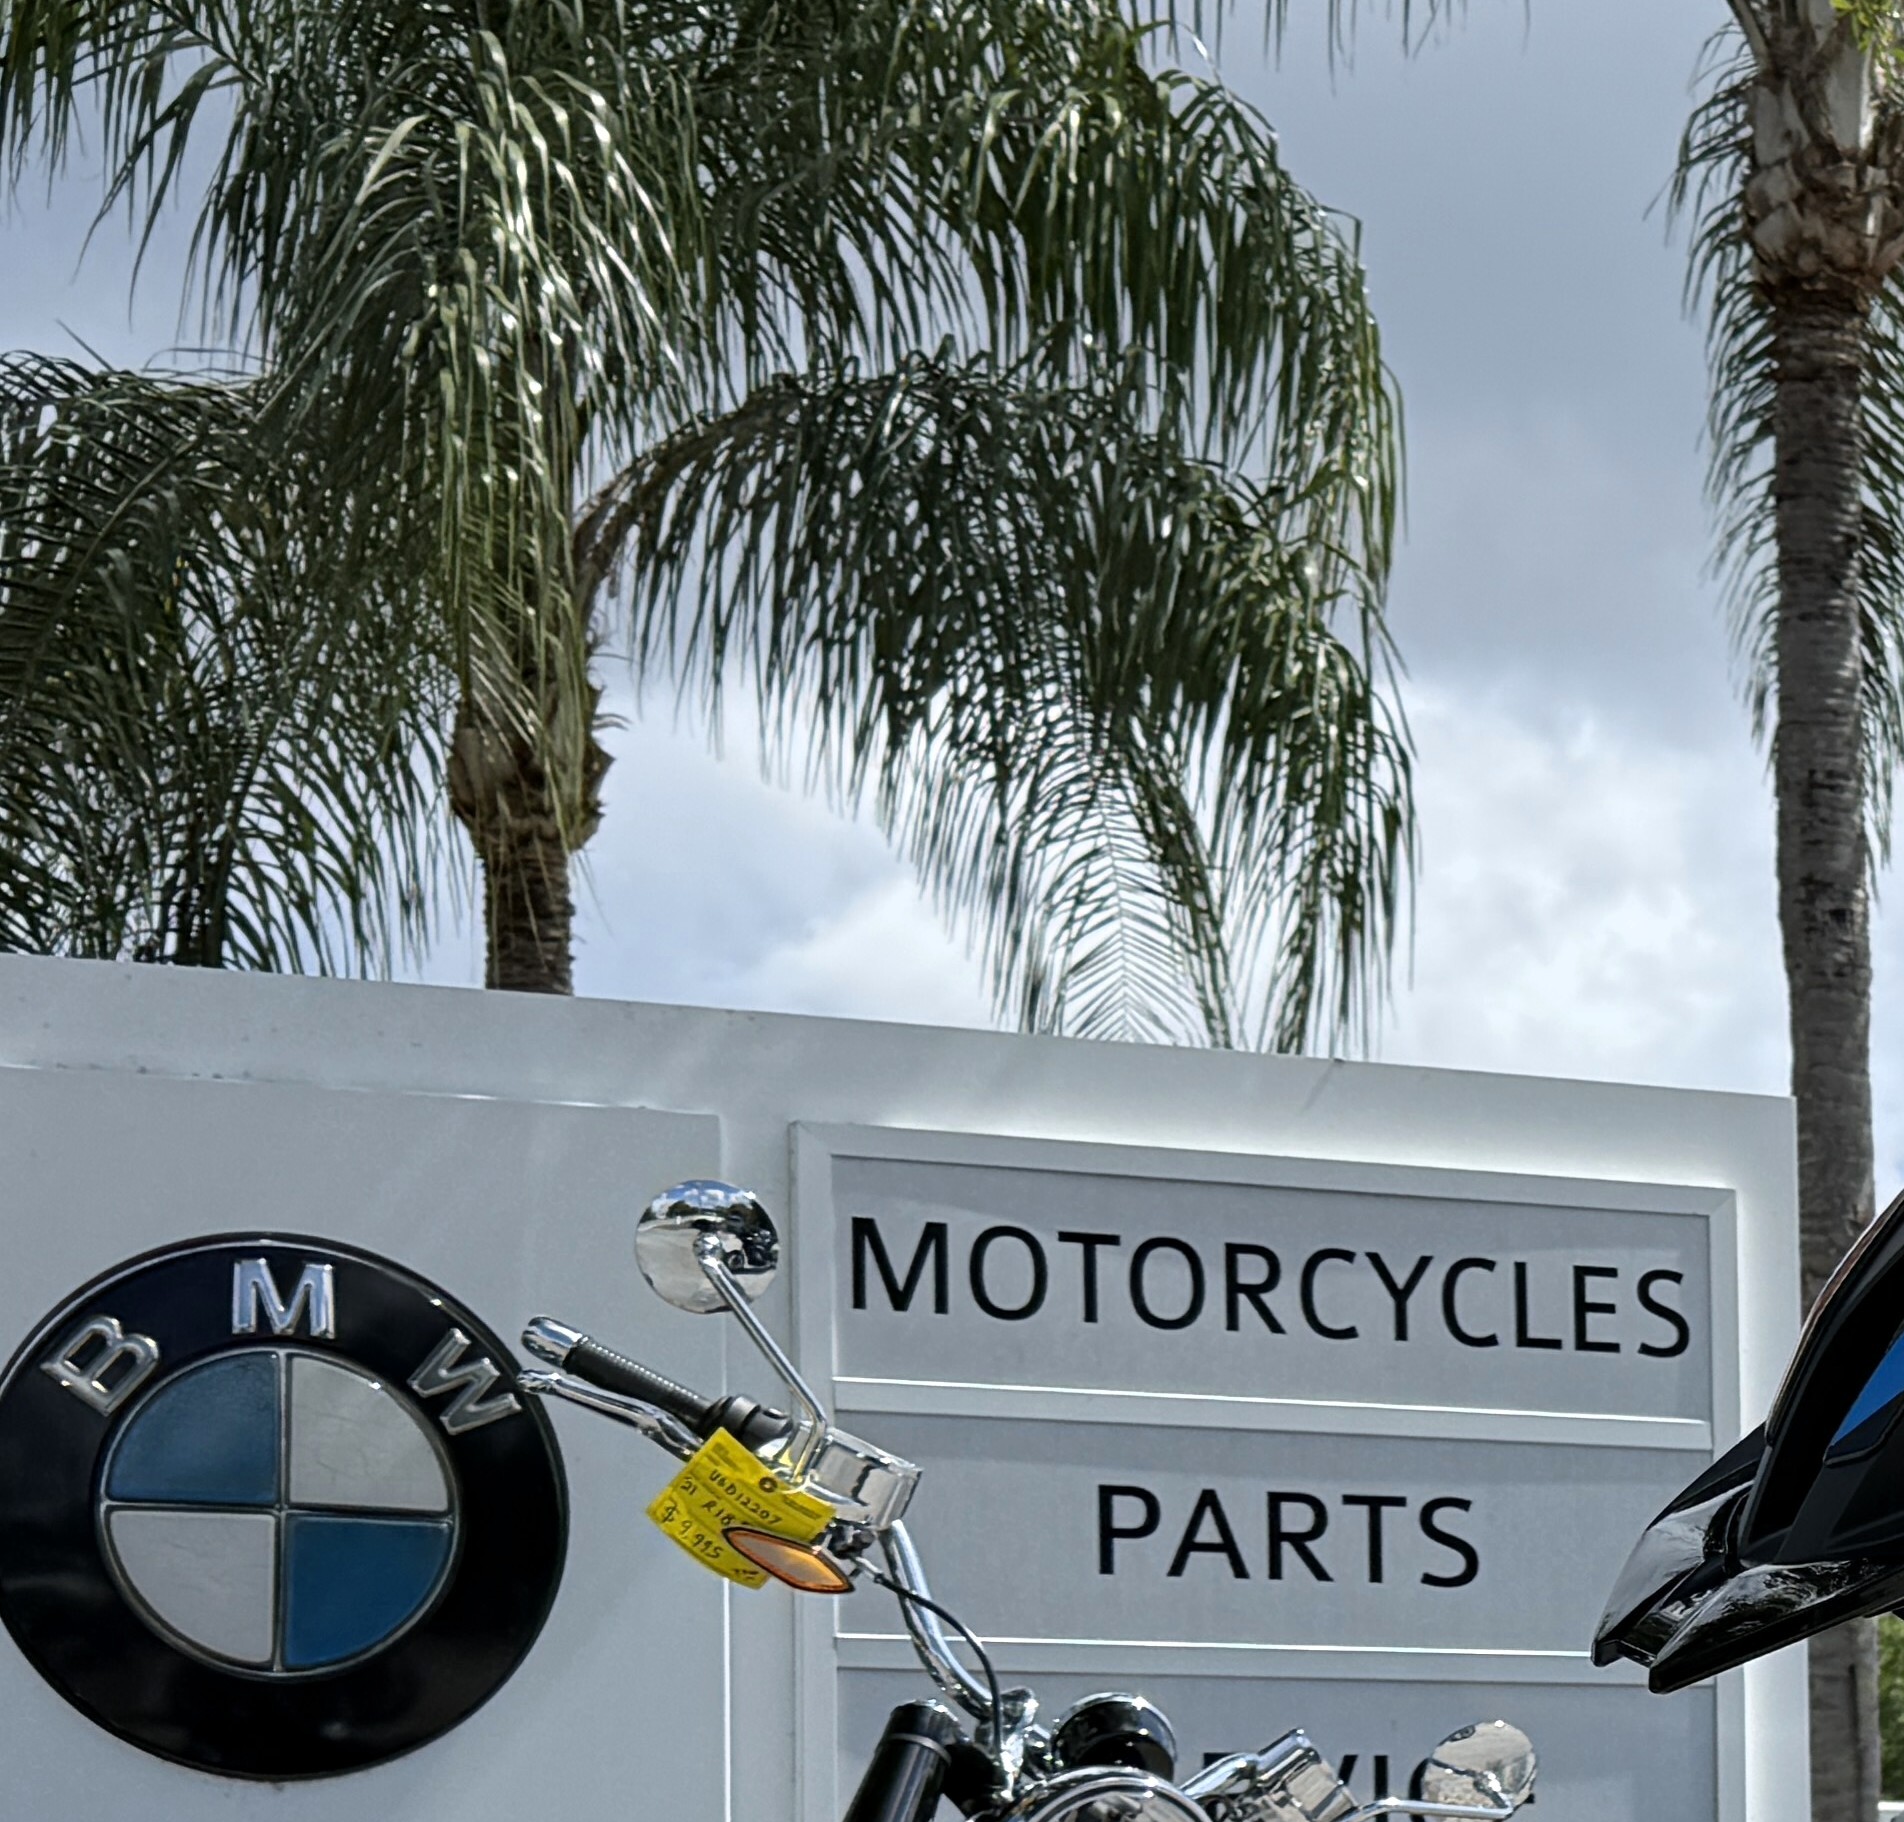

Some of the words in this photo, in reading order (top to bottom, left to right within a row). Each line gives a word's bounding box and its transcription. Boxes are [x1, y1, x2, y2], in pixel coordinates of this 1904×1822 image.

[40, 1258, 523, 1434] BMW
[850, 1217, 1691, 1358] MOTORCYCLES
[1098, 1484, 1479, 1589] PARTS
